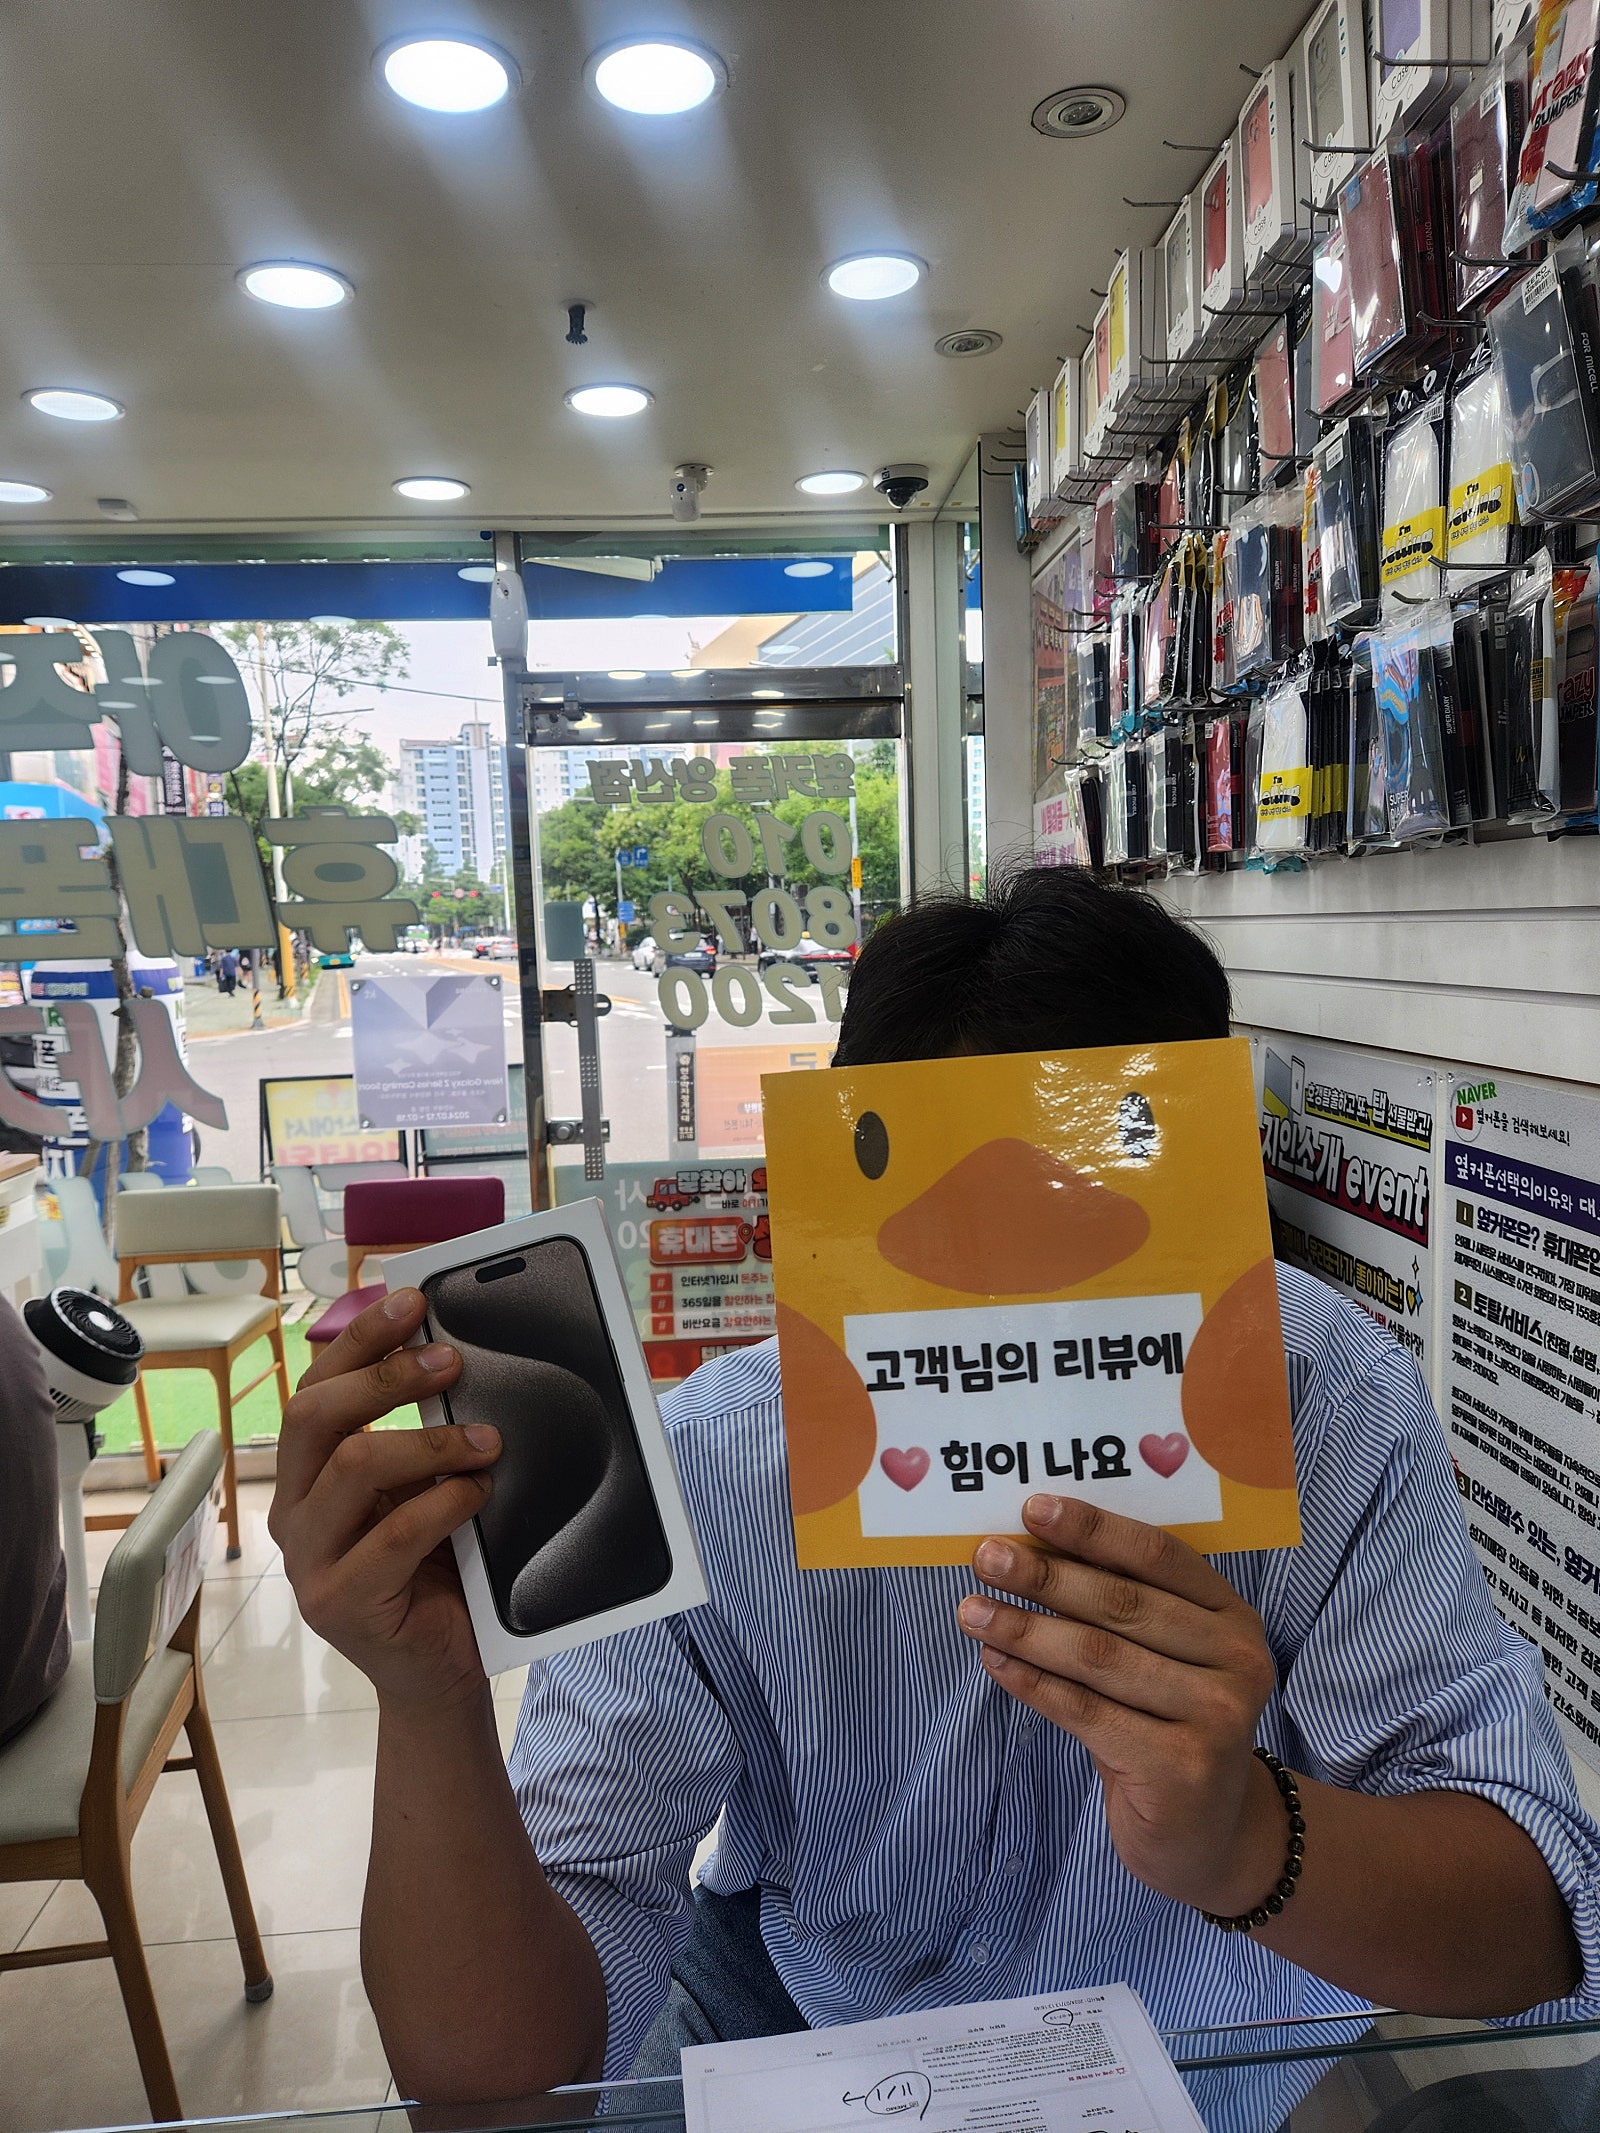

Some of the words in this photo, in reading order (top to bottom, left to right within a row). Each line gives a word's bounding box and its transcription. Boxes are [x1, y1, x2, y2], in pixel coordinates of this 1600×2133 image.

[1534, 84, 1585, 131] BUMPER
[1525, 265, 1547, 289] ZERO
[1580, 331, 1591, 355] FOR
[1558, 700, 1595, 723] UMPER
[1306, 1082, 1356, 1113] 호갱탈출하고
[1372, 1089, 1387, 1123] 탭
[1388, 1104, 1432, 1136] 선물받고!
[1457, 1082, 1497, 1105] NAVER
[1476, 1108, 1509, 1132] 옆커폰을
[1511, 1117, 1570, 1146] 검색해보세요!
[1262, 1113, 1344, 1195] 지인소개
[1345, 1153, 1431, 1229] event
[1455, 1153, 1573, 1213] 옆커폰선택의이유와
[1579, 1197, 1600, 1221] 대
[722, 1199, 739, 1209] 바로
[658, 1225, 738, 1254] 휴대폰
[1477, 1206, 1540, 1248] 옆커폰은?
[681, 1274, 739, 1287] 인터넷가입시
[1455, 1233, 1476, 1252] 언제나
[1559, 1276, 1575, 1292] 가장
[682, 1297, 721, 1308] 365일을
[1356, 1262, 1403, 1310] 좋아하는!
[1459, 1288, 1467, 1302] 2
[1482, 1263, 1516, 1287] 시스템으로
[1558, 1298, 1574, 1314] 전국
[682, 1318, 721, 1329] 비싼요금
[866, 1341, 1039, 1394] 고객님의
[1053, 1332, 1185, 1381] 리뷰에
[1568, 1373, 1600, 1401] 사람들이
[940, 1440, 1030, 1492] 힘이
[1043, 1434, 1131, 1482] 나요
[1472, 1480, 1525, 1535] 안심할수
[1528, 1520, 1561, 1567] 있는,
[1564, 1545, 1600, 1596] 옆커
[1469, 1523, 1507, 1563] 성지매장
[1509, 1553, 1539, 1591] 인증을
[1542, 1578, 1564, 1609] 위한
[1499, 1578, 1529, 1615] 무사고
[1531, 1604, 1542, 1625] 등
[1545, 1615, 1578, 1655] 철저한
[1565, 1669, 1589, 1700] 고객
[885, 2103, 907, 2112] MEMO
